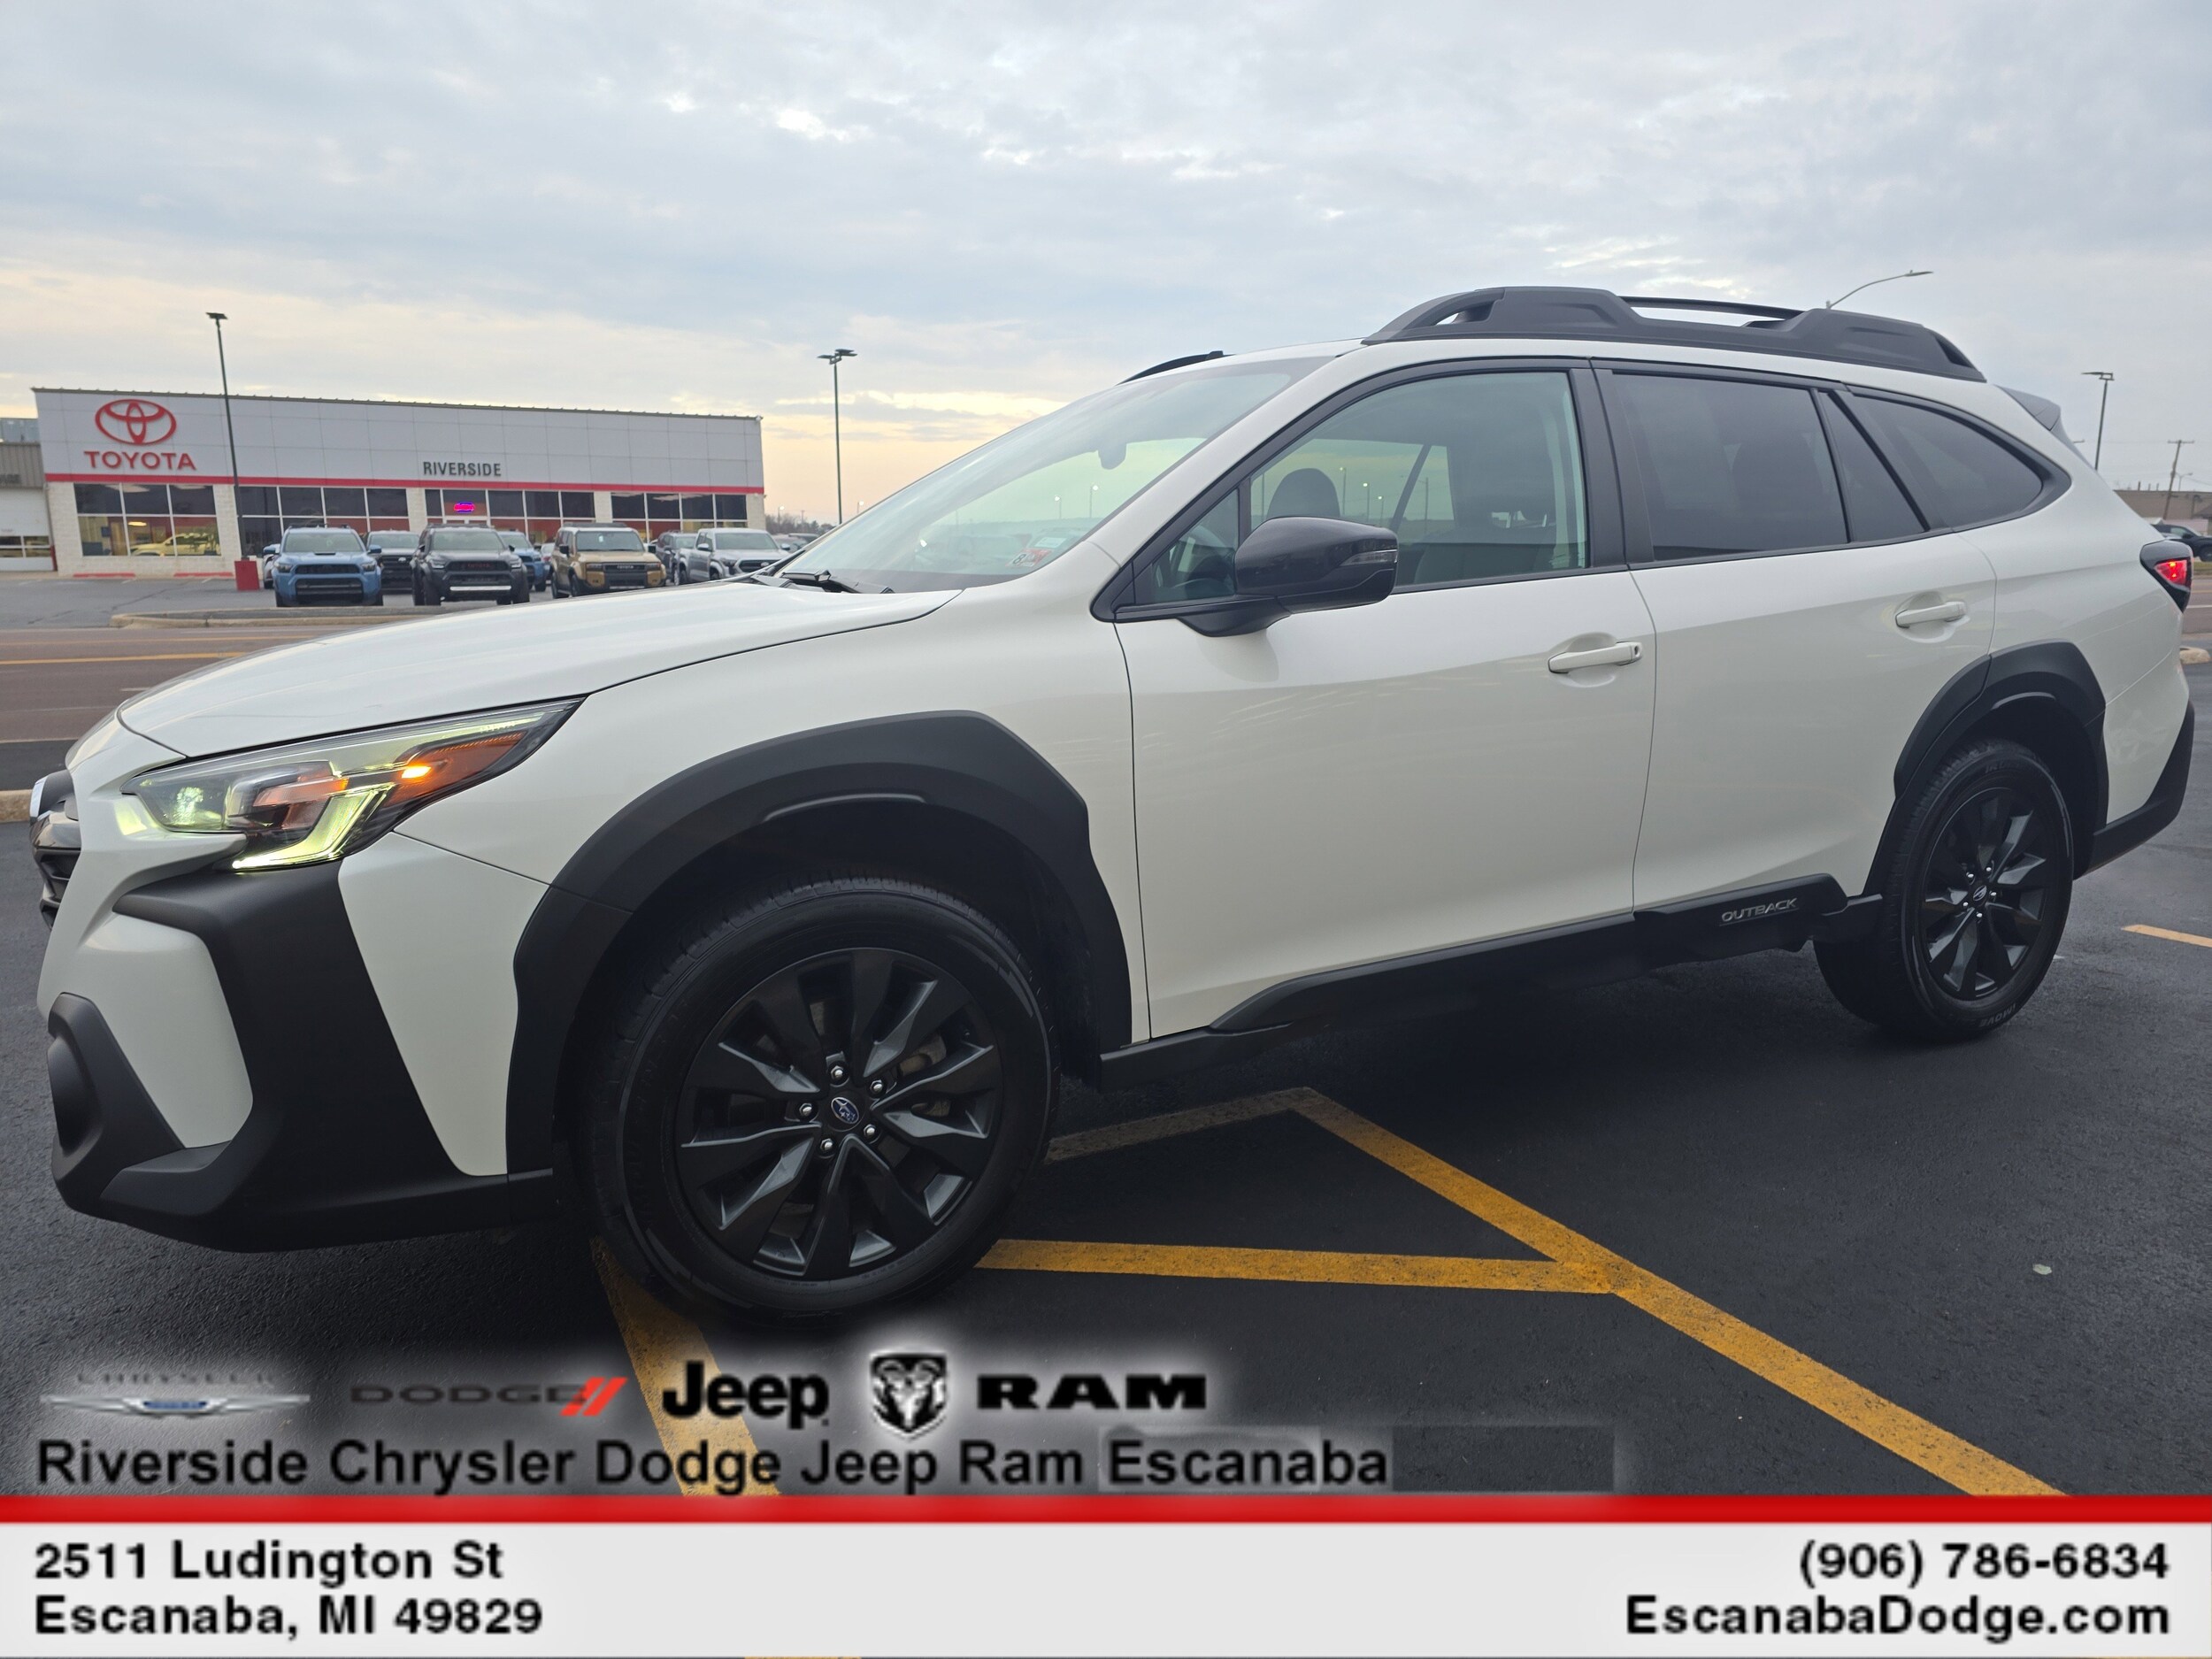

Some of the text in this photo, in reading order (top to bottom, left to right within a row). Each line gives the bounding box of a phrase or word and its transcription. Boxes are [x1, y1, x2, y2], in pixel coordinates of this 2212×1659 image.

[84, 450, 196, 471] TOYOTA
[423, 461, 502, 478] RIVERSIDE
[1721, 897, 1798, 922] OUTBACK
